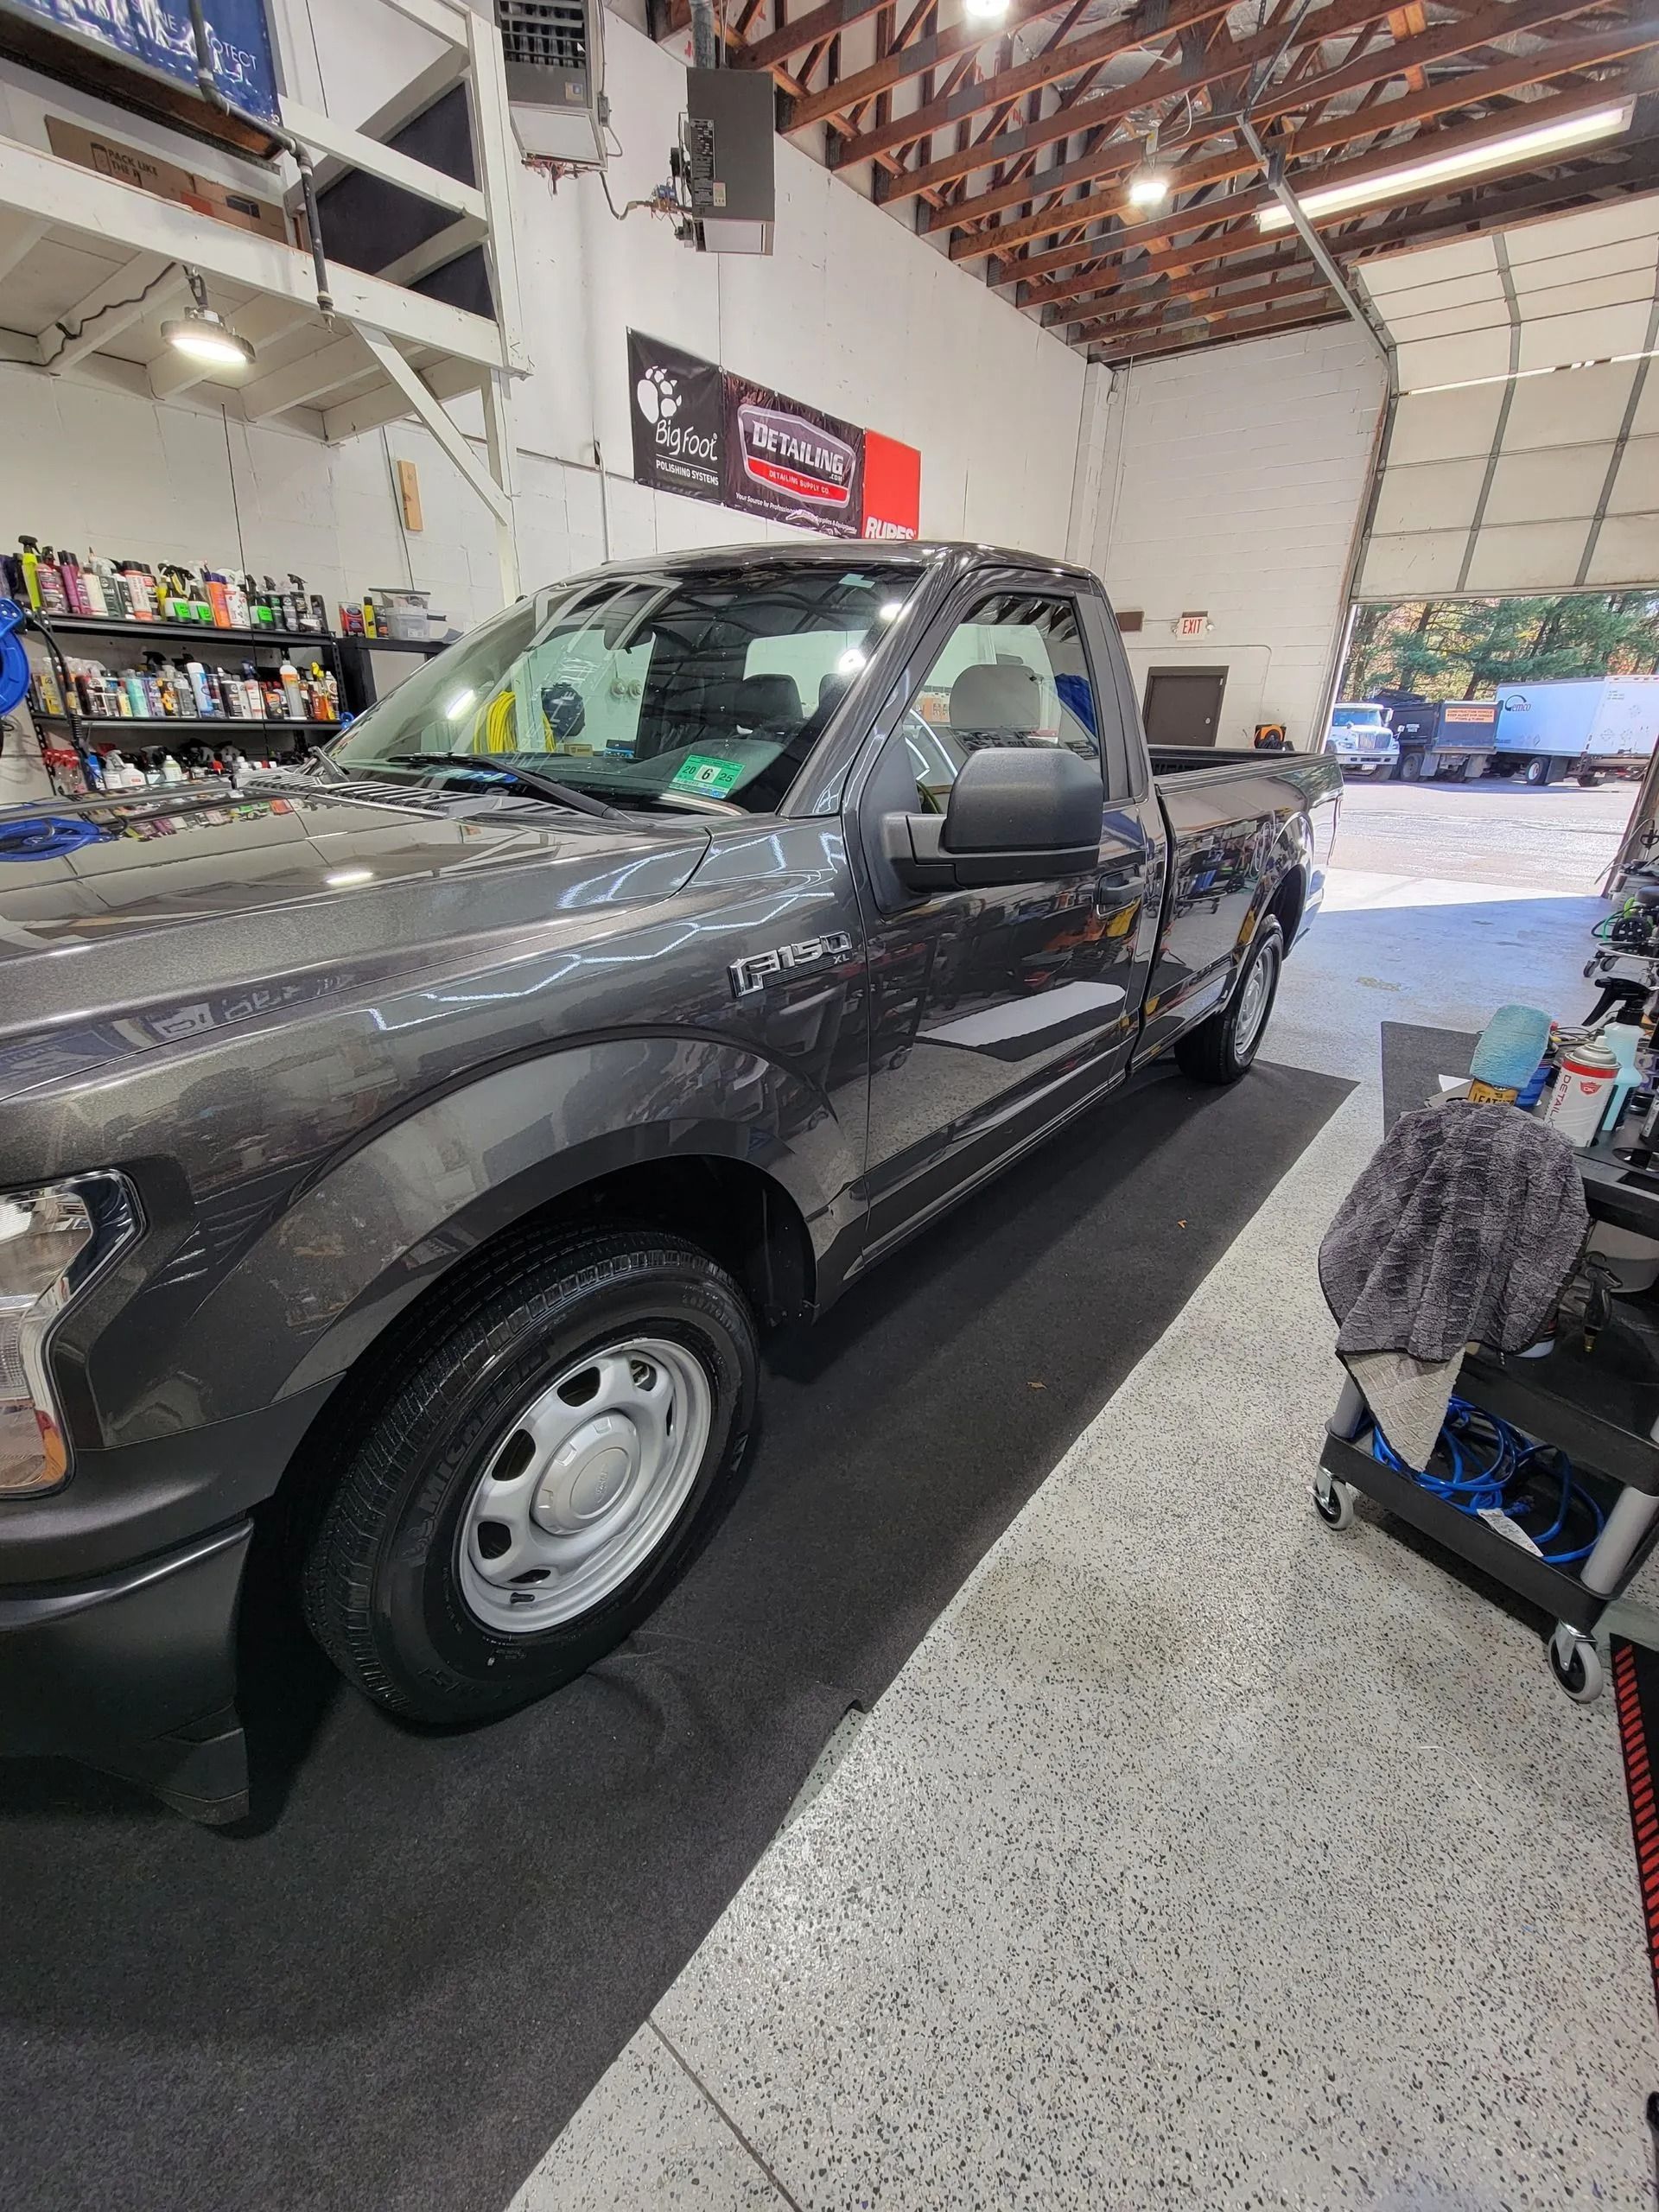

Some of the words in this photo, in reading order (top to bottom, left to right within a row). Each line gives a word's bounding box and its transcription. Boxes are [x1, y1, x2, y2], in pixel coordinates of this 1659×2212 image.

[209, 37, 257, 71] OTECT
[752, 420, 844, 476] DETAILING
[656, 459, 691, 479] POLISHING
[691, 469, 719, 486] SYSTEMS
[768, 469, 798, 485] DETAILING
[798, 479, 820, 492] SUPPLY
[735, 492, 747, 500] Your
[747, 495, 764, 506] Source
[1182, 619, 1203, 634] EXIT
[683, 766, 696, 775] 20
[702, 768, 714, 780] 6
[718, 772, 734, 783] 25
[833, 954, 850, 965] XL
